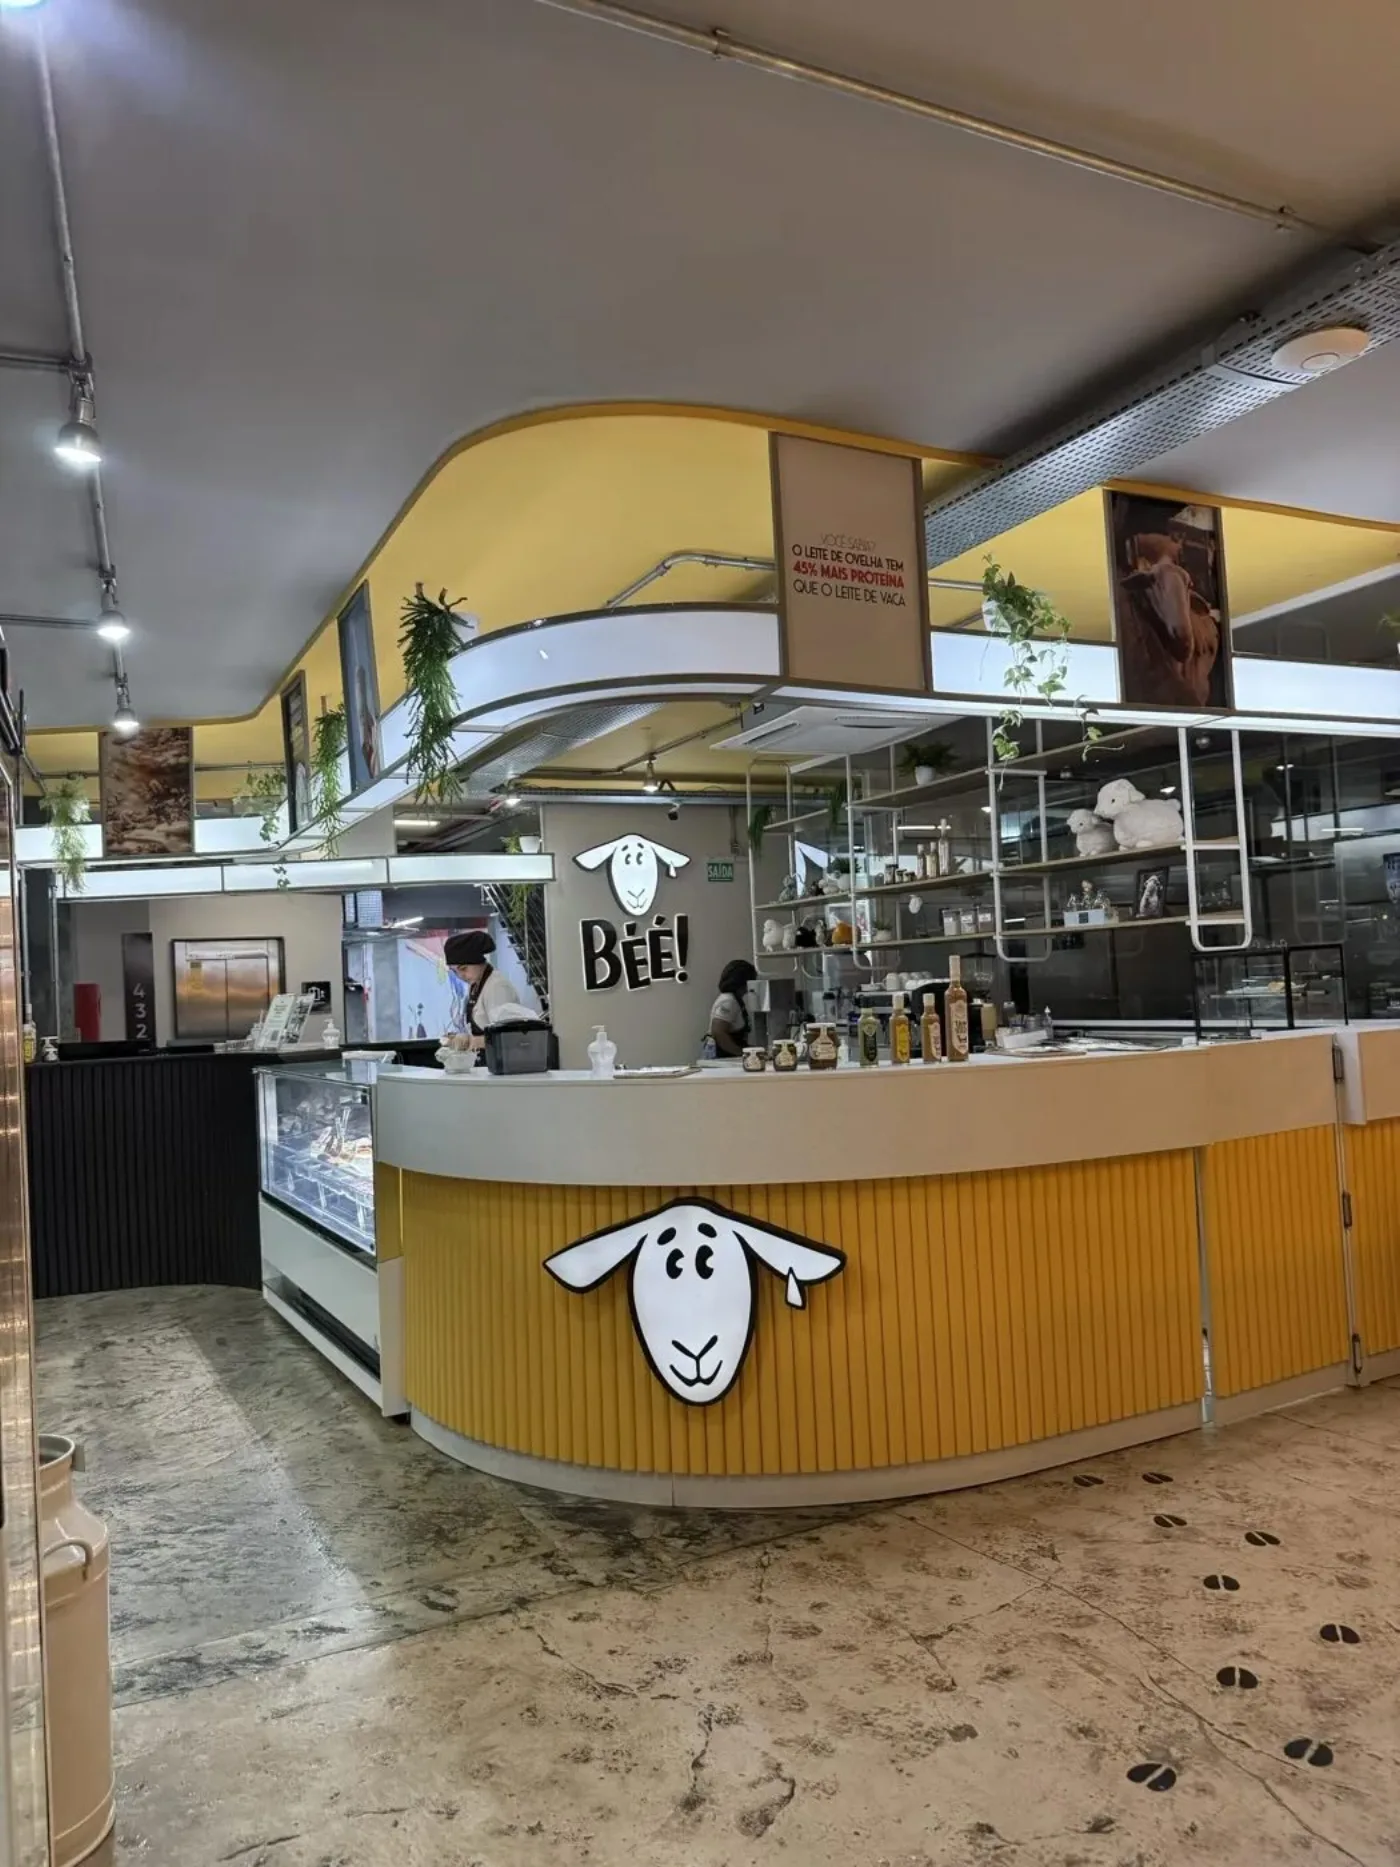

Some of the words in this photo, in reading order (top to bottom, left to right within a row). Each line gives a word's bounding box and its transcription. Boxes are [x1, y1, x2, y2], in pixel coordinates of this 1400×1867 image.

[792, 544, 802, 556] O
[805, 545, 828, 561] LEITE
[831, 550, 842, 563] DE
[845, 552, 883, 569] OVELHA
[885, 558, 904, 572] TEM
[793, 560, 818, 577] 45%
[821, 564, 848, 581] MAIS
[851, 568, 904, 588] PROTEÍNA
[793, 579, 818, 596] QUE
[821, 583, 832, 597] O
[836, 585, 860, 601] LEITE
[864, 589, 877, 603] DE
[880, 591, 906, 606] VACA
[708, 863, 733, 878] SAÍDA
[132, 982, 146, 998] 4
[135, 1003, 147, 1018] 3
[136, 1023, 148, 1039] 2
